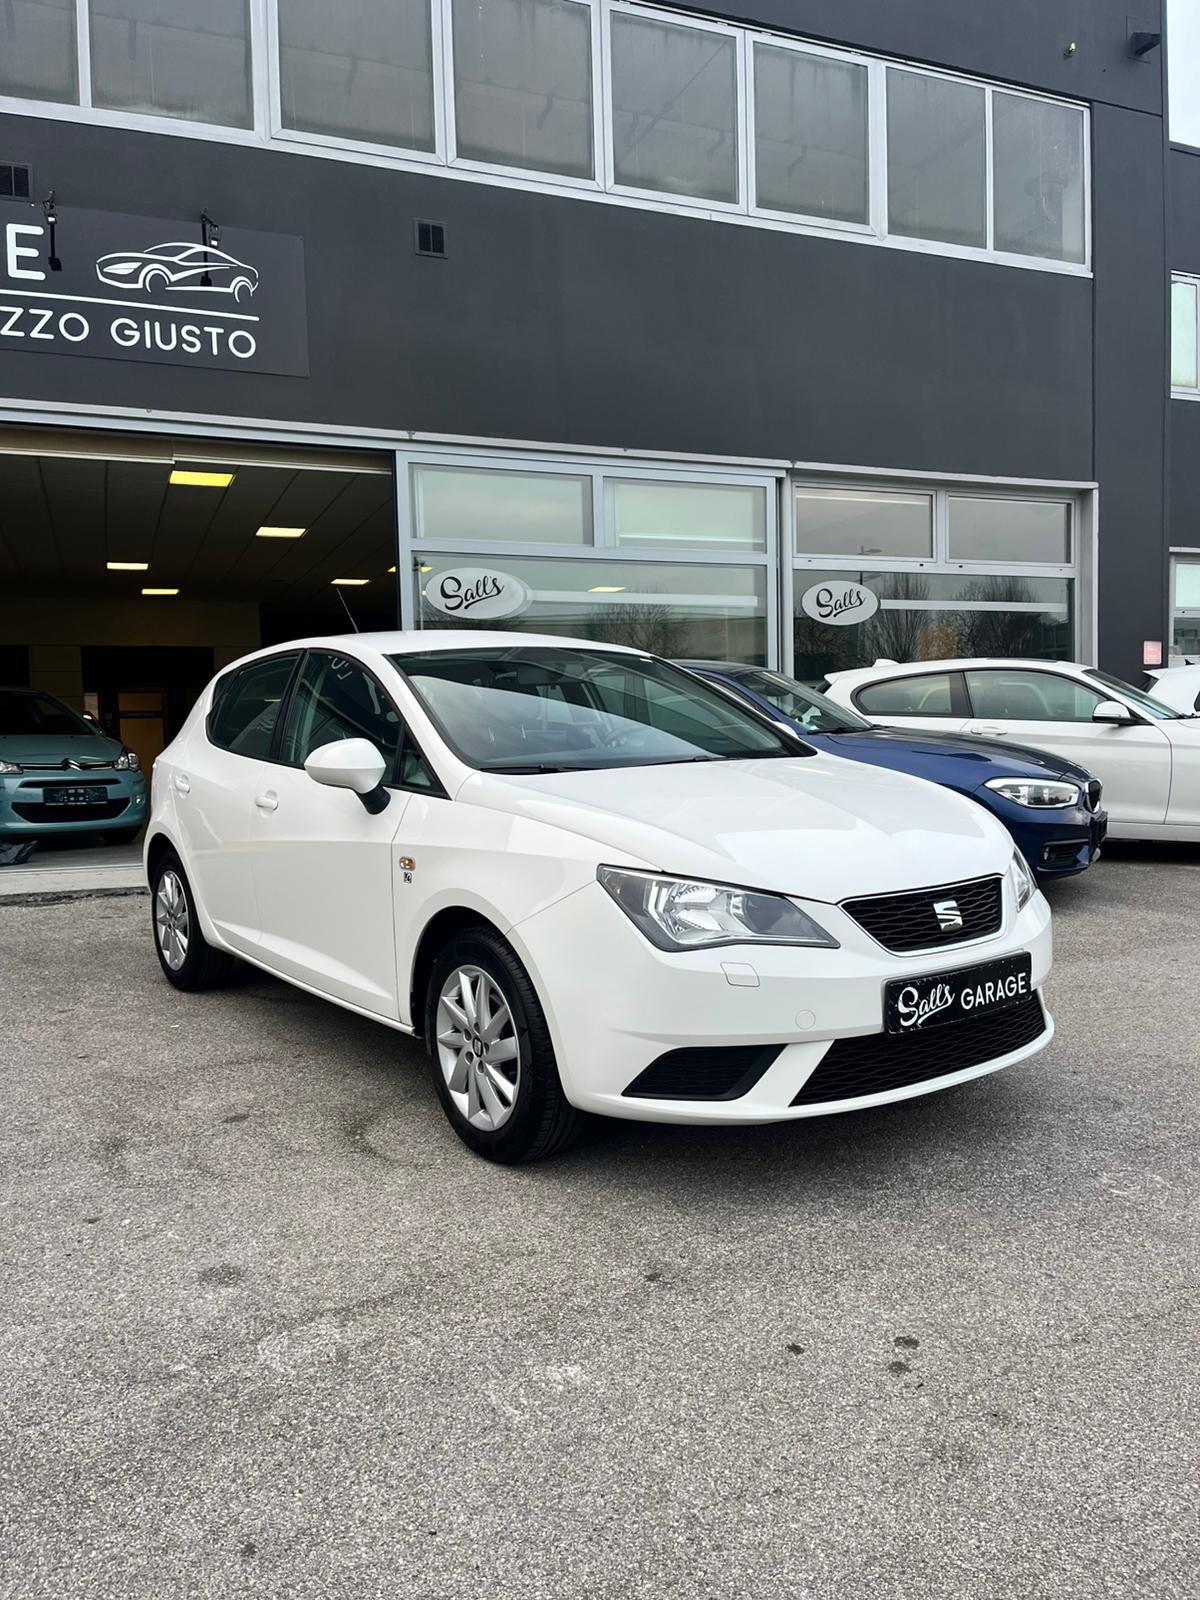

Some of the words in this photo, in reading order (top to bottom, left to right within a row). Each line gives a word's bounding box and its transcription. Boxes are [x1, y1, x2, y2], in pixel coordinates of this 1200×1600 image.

[0, 306, 90, 342] ZZO
[110, 317, 256, 359] GIUSTO
[961, 972, 1027, 1010] GARAGE
